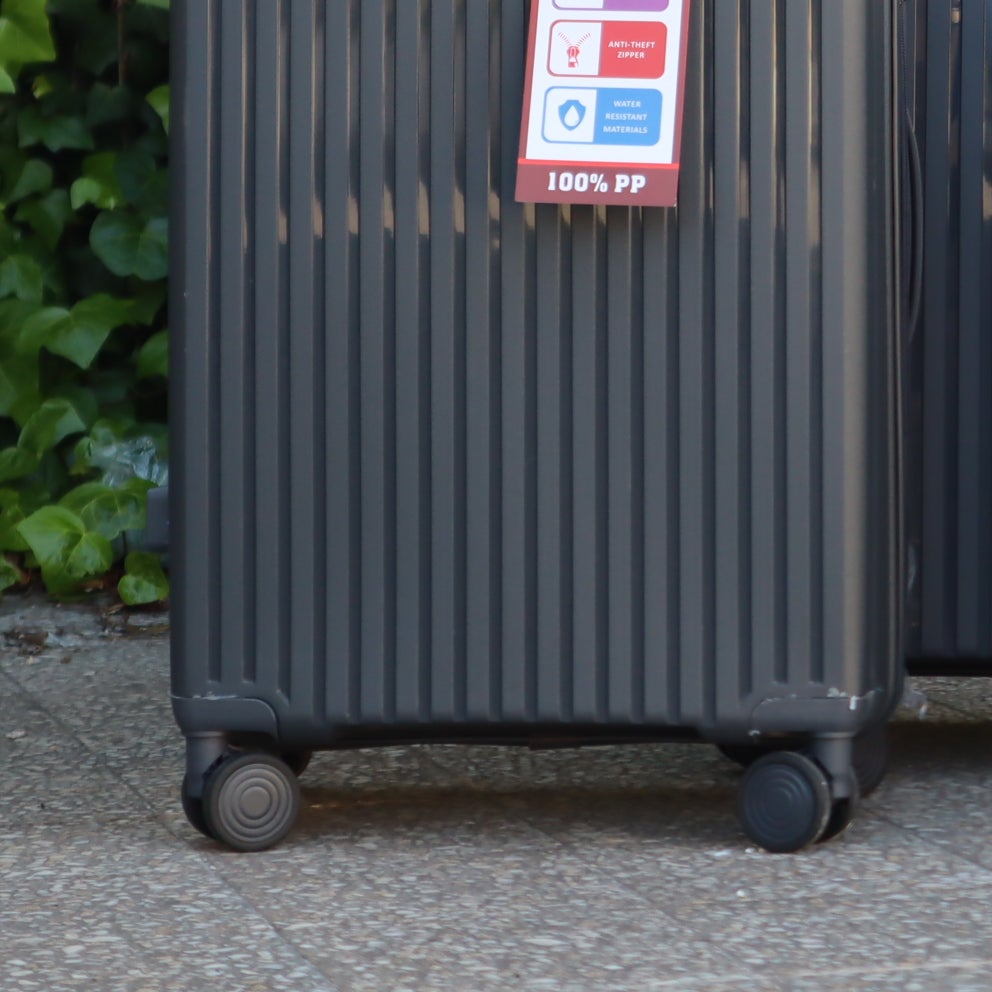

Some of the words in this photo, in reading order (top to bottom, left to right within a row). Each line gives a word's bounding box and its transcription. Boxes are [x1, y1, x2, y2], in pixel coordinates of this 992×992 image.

[608, 40, 655, 49] ANTI-THEFT
[617, 51, 645, 59] ZIPPER
[613, 100, 641, 108] WATER
[605, 113, 647, 121] RESISTANT
[603, 126, 648, 134] MATERIALS
[547, 171, 608, 193] 100%
[614, 174, 646, 194] PP
